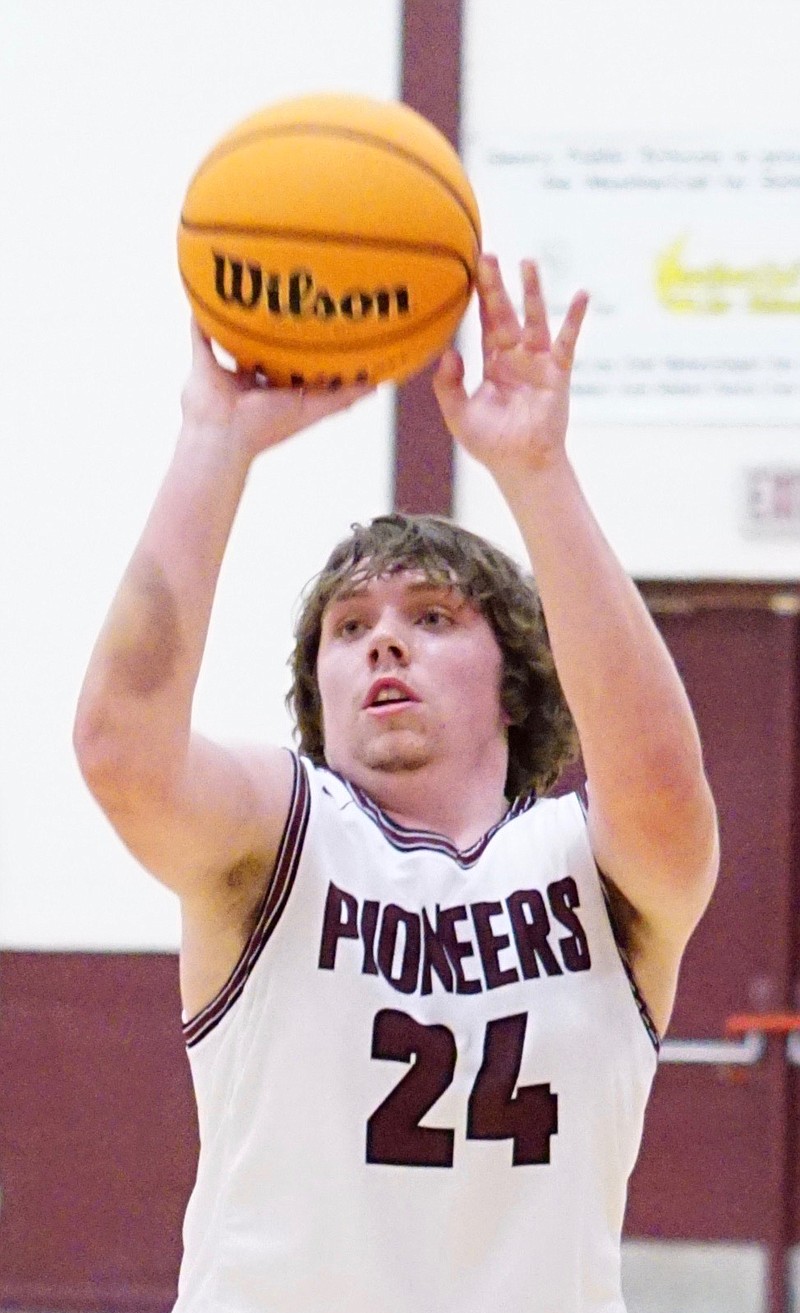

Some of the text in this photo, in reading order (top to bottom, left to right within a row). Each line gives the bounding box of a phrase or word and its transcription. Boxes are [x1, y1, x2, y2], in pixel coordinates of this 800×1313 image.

[211, 250, 410, 319] Wilson
[318, 876, 592, 996] PIONEERS
[365, 1007, 559, 1168] 24
